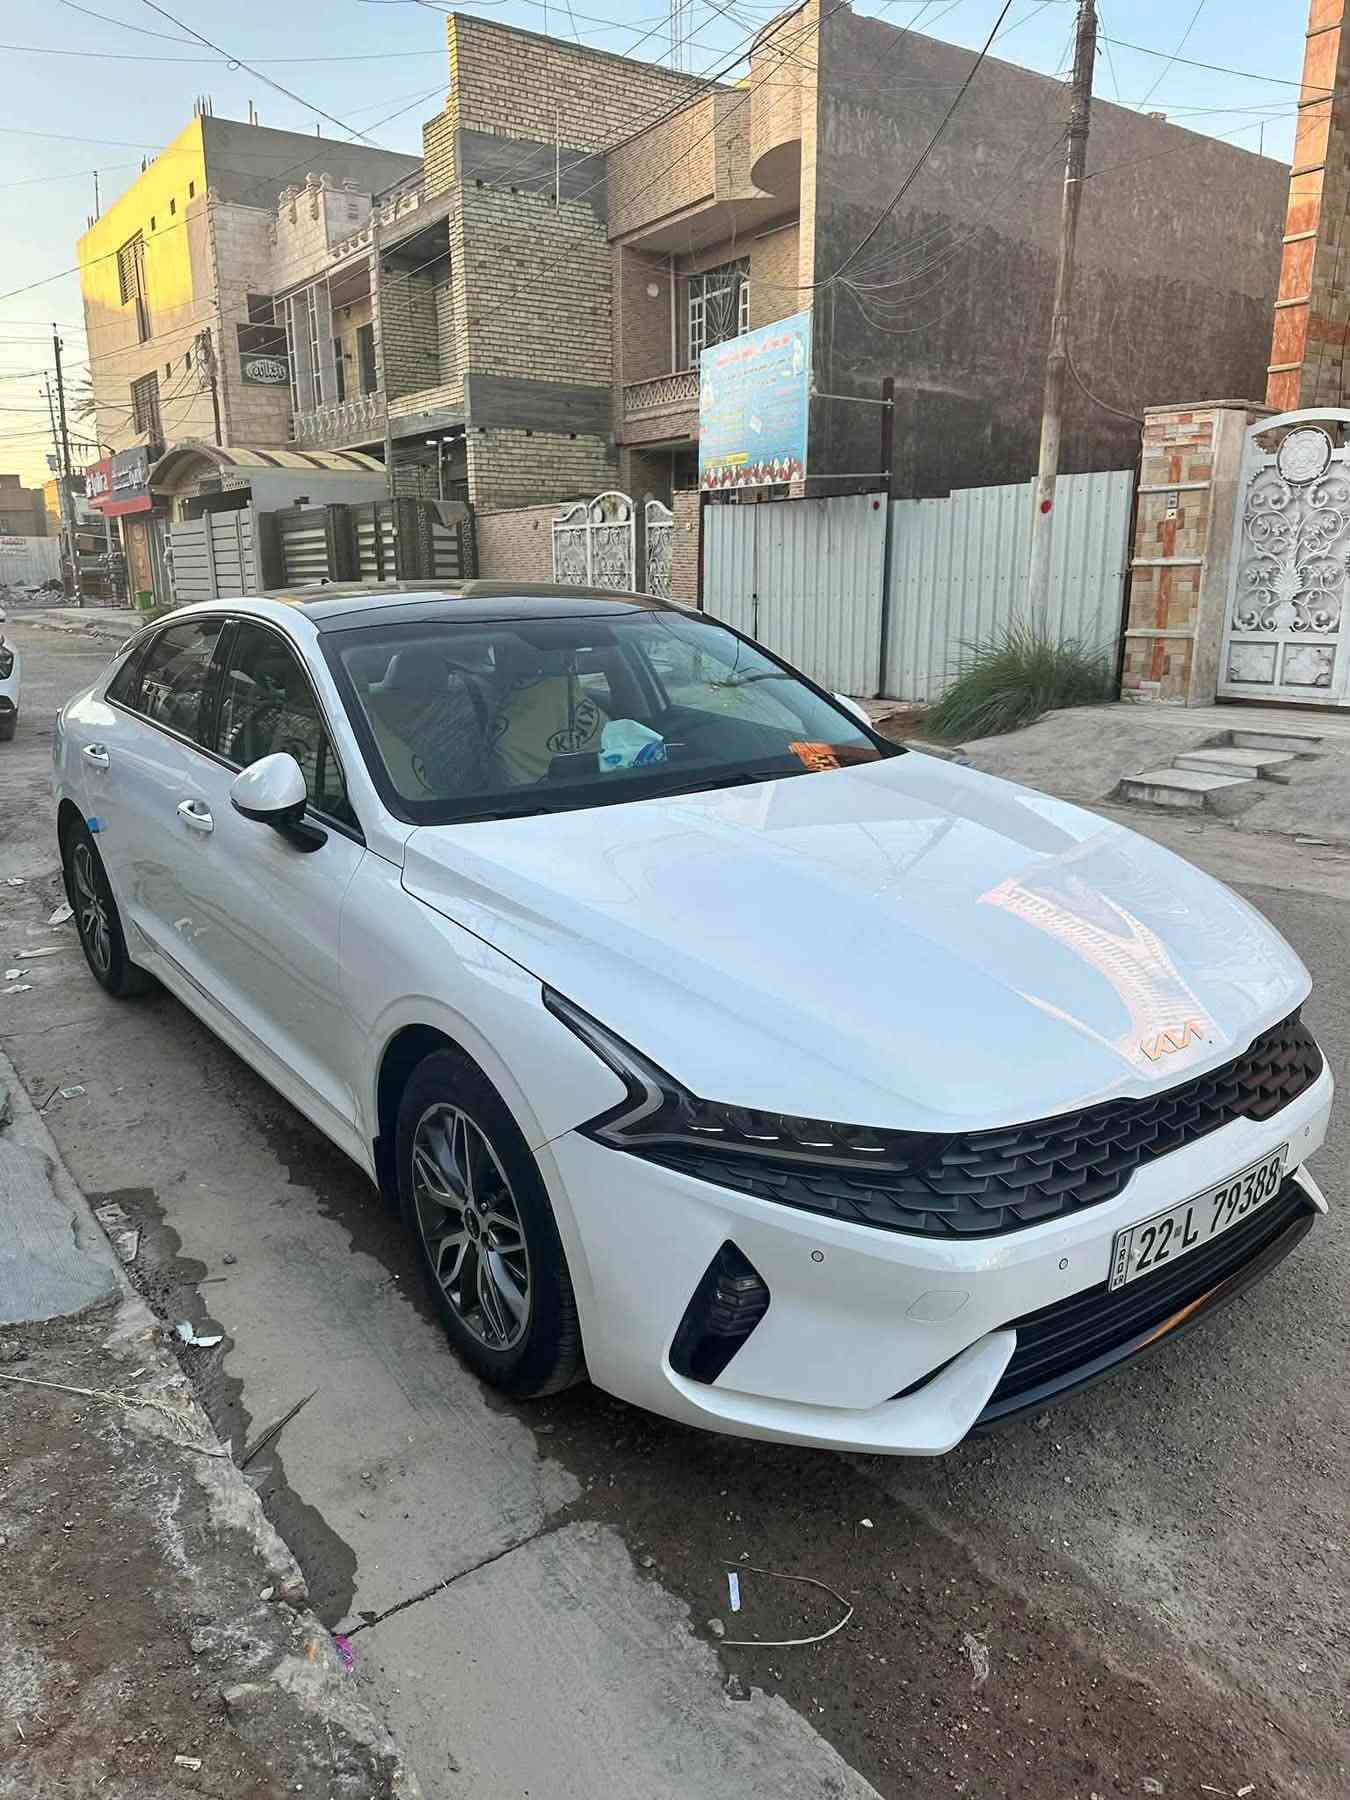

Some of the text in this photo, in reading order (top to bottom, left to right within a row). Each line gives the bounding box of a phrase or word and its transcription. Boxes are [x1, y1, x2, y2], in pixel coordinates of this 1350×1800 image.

[1135, 1157, 1280, 1272] 22 L 79388
